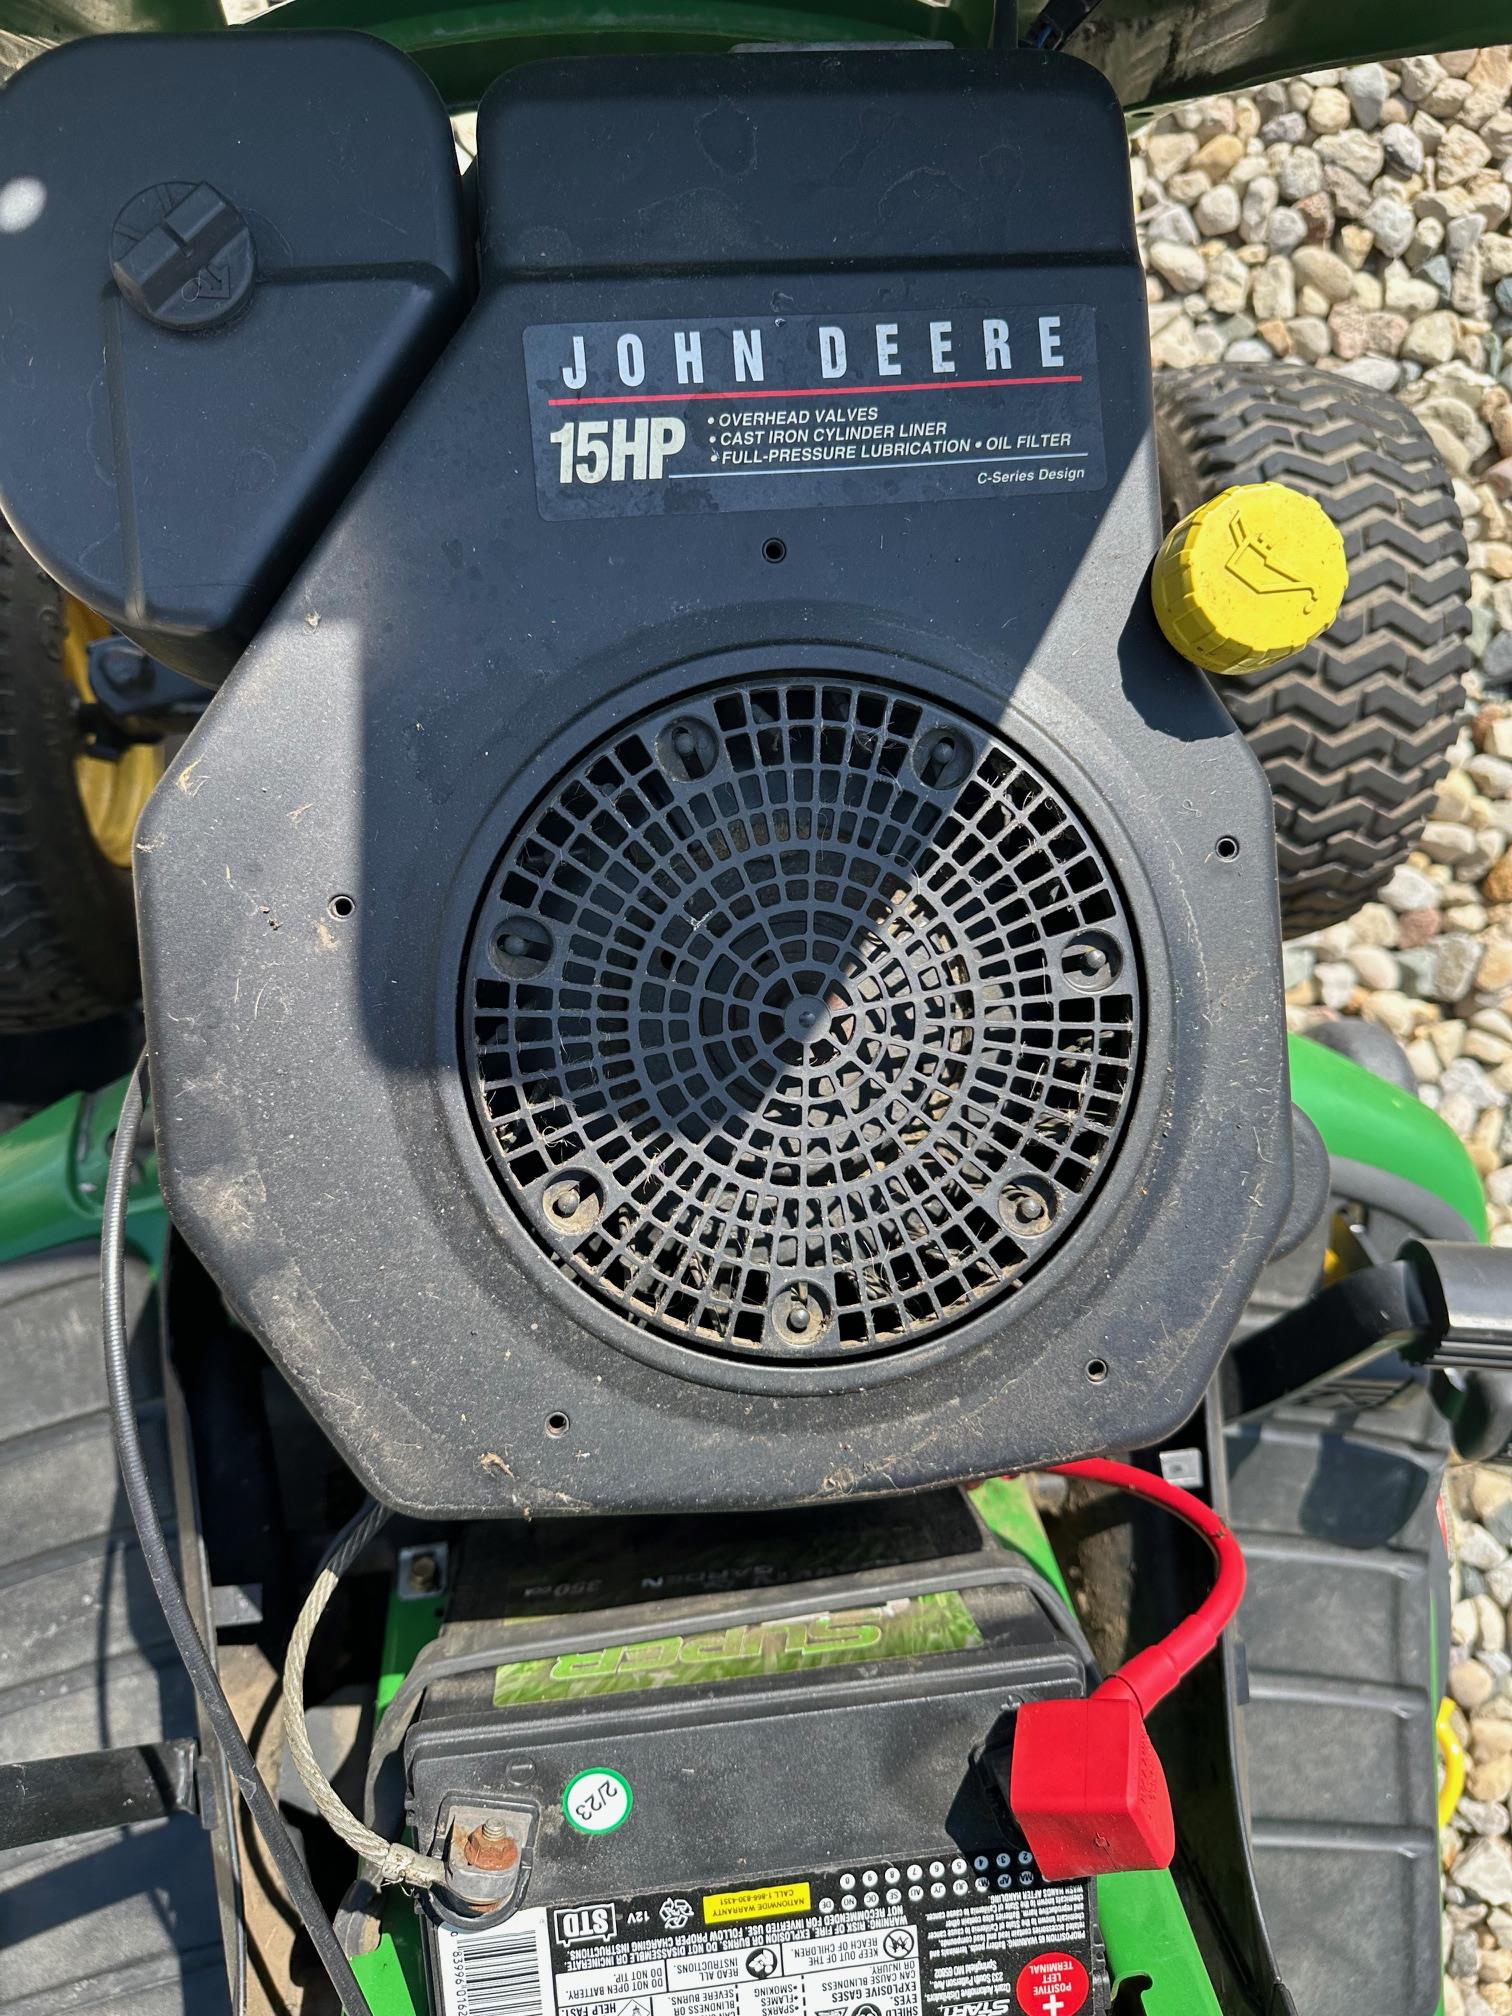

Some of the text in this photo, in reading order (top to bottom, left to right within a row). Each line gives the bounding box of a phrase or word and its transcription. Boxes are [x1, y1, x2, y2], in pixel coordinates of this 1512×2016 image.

[562, 316, 1064, 390] JOHN DEERE
[719, 407, 878, 427] OVERHEAD VALVES
[720, 422, 947, 446] CAST IRON CYLINDER LINER
[550, 417, 685, 485] 15HP
[722, 433, 1071, 464] FULL-PRESSURE LUBRICATION OIL FILTER
[977, 467, 1085, 484] C-Series Design
[575, 1779, 618, 1821] 2/23
[775, 1889, 794, 1898] CALL
[712, 1898, 804, 1916] NATIONWIDE WARRANTY
[563, 1908, 608, 1937] STD
[627, 1911, 650, 1924] 12V
[867, 1915, 908, 1929] WARNING:
[567, 1905, 903, 1960] NOT RECOMMENDED FOR INVERTED USE. FOLLOW PROPER CHARGING INSTRUCTIONS.
[834, 1924, 844, 1933] OF
[847, 1921, 865, 1931] RISK
[720, 1937, 750, 1949] BURNS.
[752, 1936, 763, 1947] OR
[766, 1928, 810, 1944] EXPLOSION
[1046, 1930, 1085, 1942] PROPOSITION
[630, 1945, 685, 1962] DISASSEMBLE
[688, 1944, 704, 1954] NOT
[706, 1942, 717, 1952] DO
[791, 1938, 877, 1958] REACH OF CHILDREN.
[564, 1957, 614, 1971] INCINERATE.
[616, 1955, 627, 1964] OR
[809, 1948, 878, 1966] KEEP OUT OF THE
[674, 1957, 737, 1974] INSTRUCTIONS.
[870, 1961, 915, 1974] OR INJURY.
[1029, 1961, 1073, 1973] TERMINAL
[614, 1968, 662, 1982] DO NOT TIP.
[699, 1968, 738, 1981] READ ALL
[822, 1970, 915, 1991] CAN CAUSE BLINDNESS
[1042, 1973, 1061, 1983] LEFT
[566, 1978, 663, 1999] DO NOT OPEN BATTERY.
[832, 1982, 916, 2003] EXPLOSIVE GASES
[1033, 1982, 1072, 1995] POSITIVE
[668, 1989, 734, 2005] SEVERE BURNS.
[890, 1994, 917, 2006] EYES.
[562, 2003, 616, 2016] HELP FAST.
[674, 2001, 734, 2016] BLINDNESS OR
[886, 2006, 918, 2016] SHIELD
